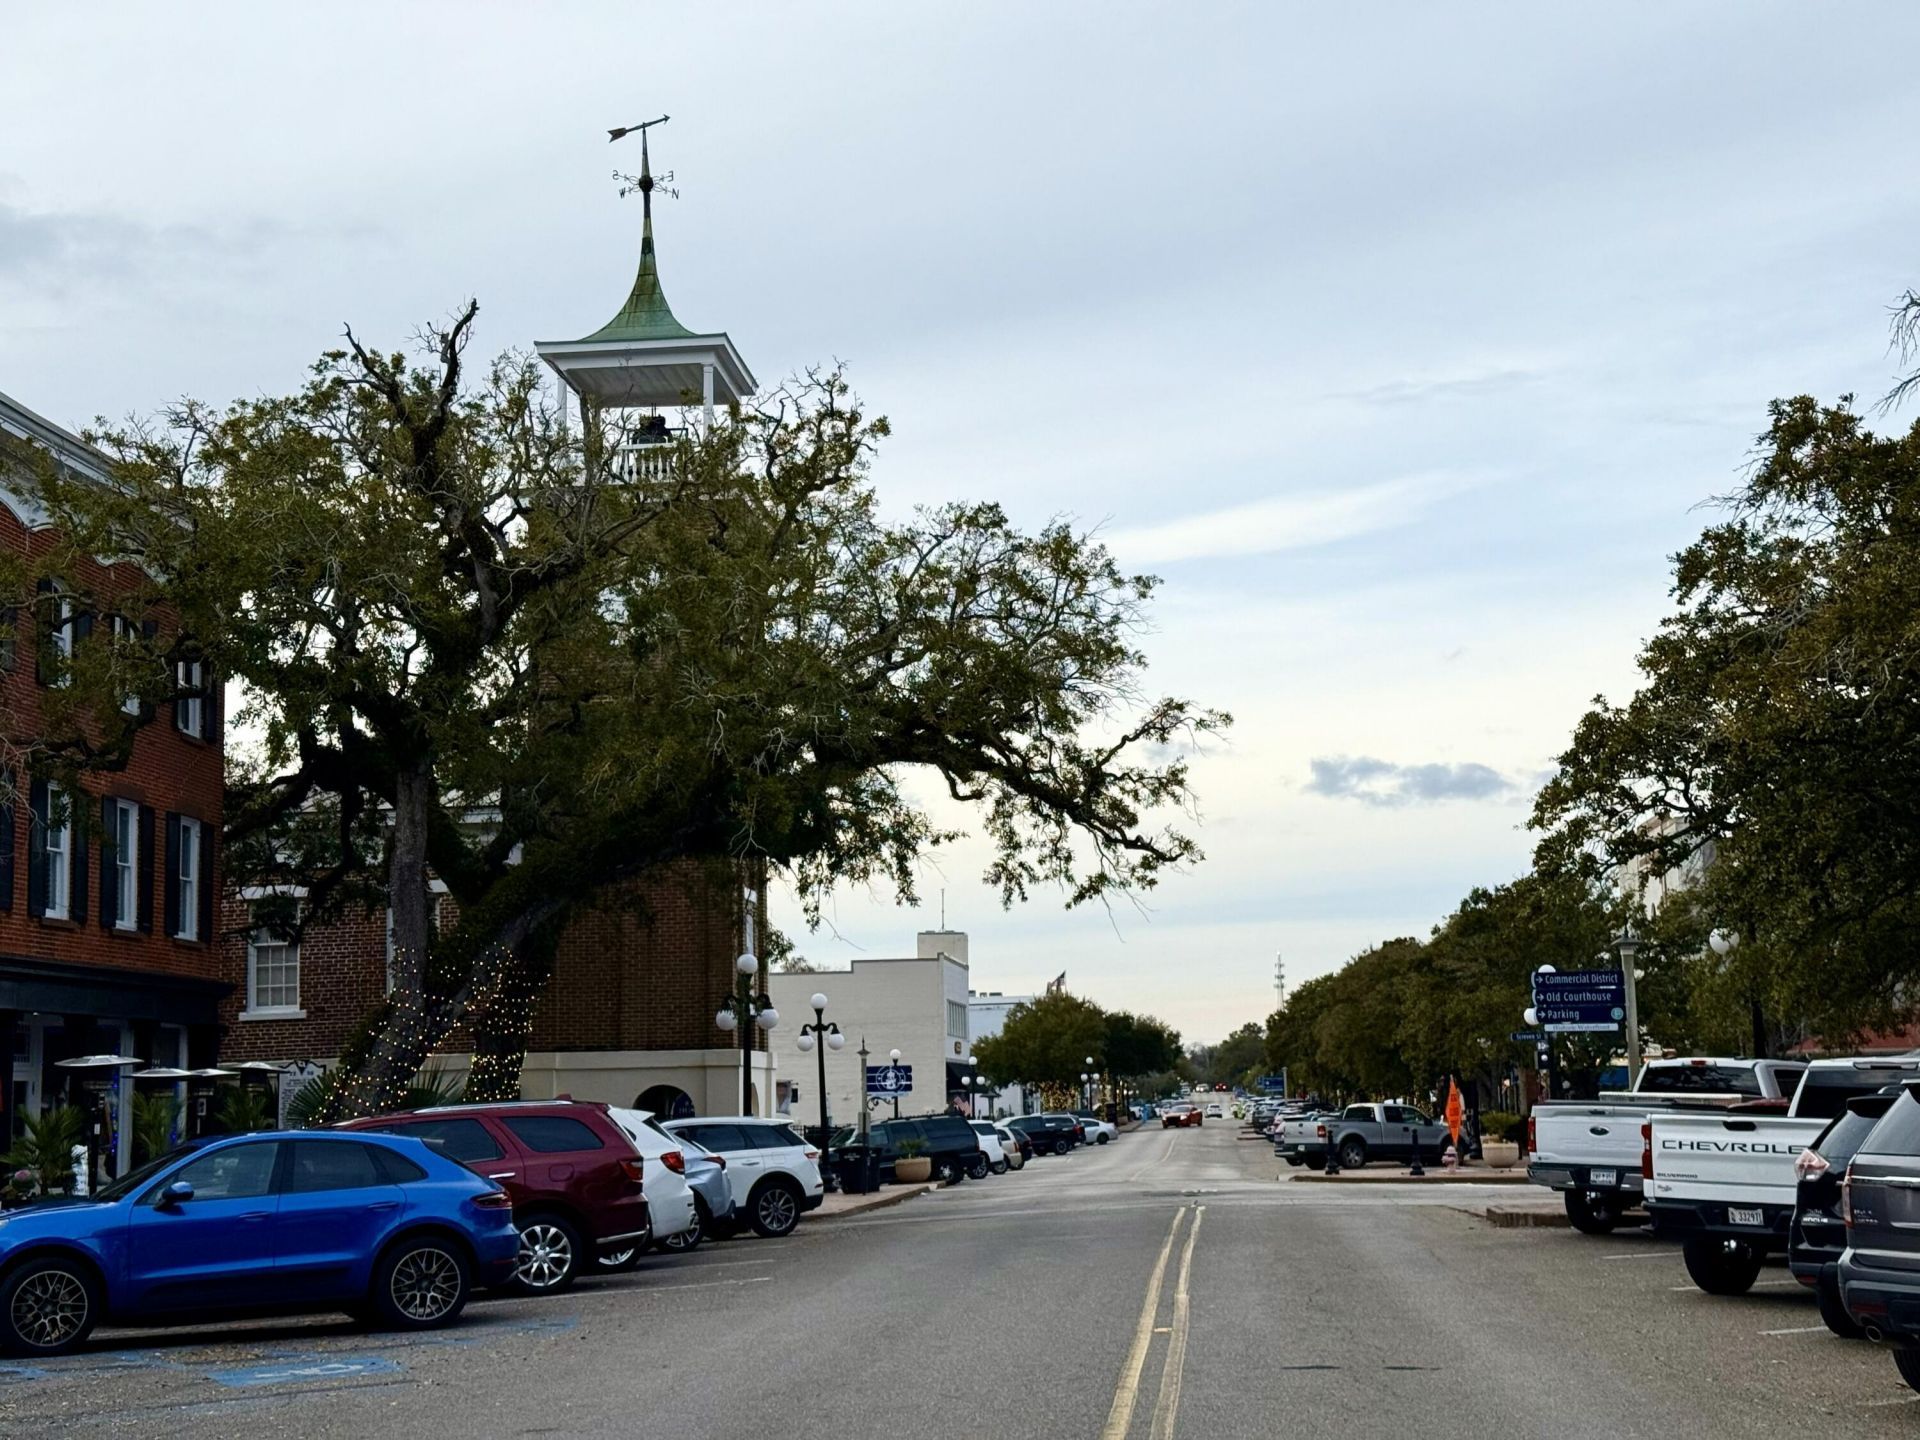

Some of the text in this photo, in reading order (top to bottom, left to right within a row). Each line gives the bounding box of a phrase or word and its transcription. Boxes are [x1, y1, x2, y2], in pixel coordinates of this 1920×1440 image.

[1545, 973, 1618, 984] Commercial District
[1546, 992, 1612, 1002] Old Courthouse
[1547, 1010, 1580, 1020] Parking
[1662, 1139, 1809, 1155] CHEVROLE
